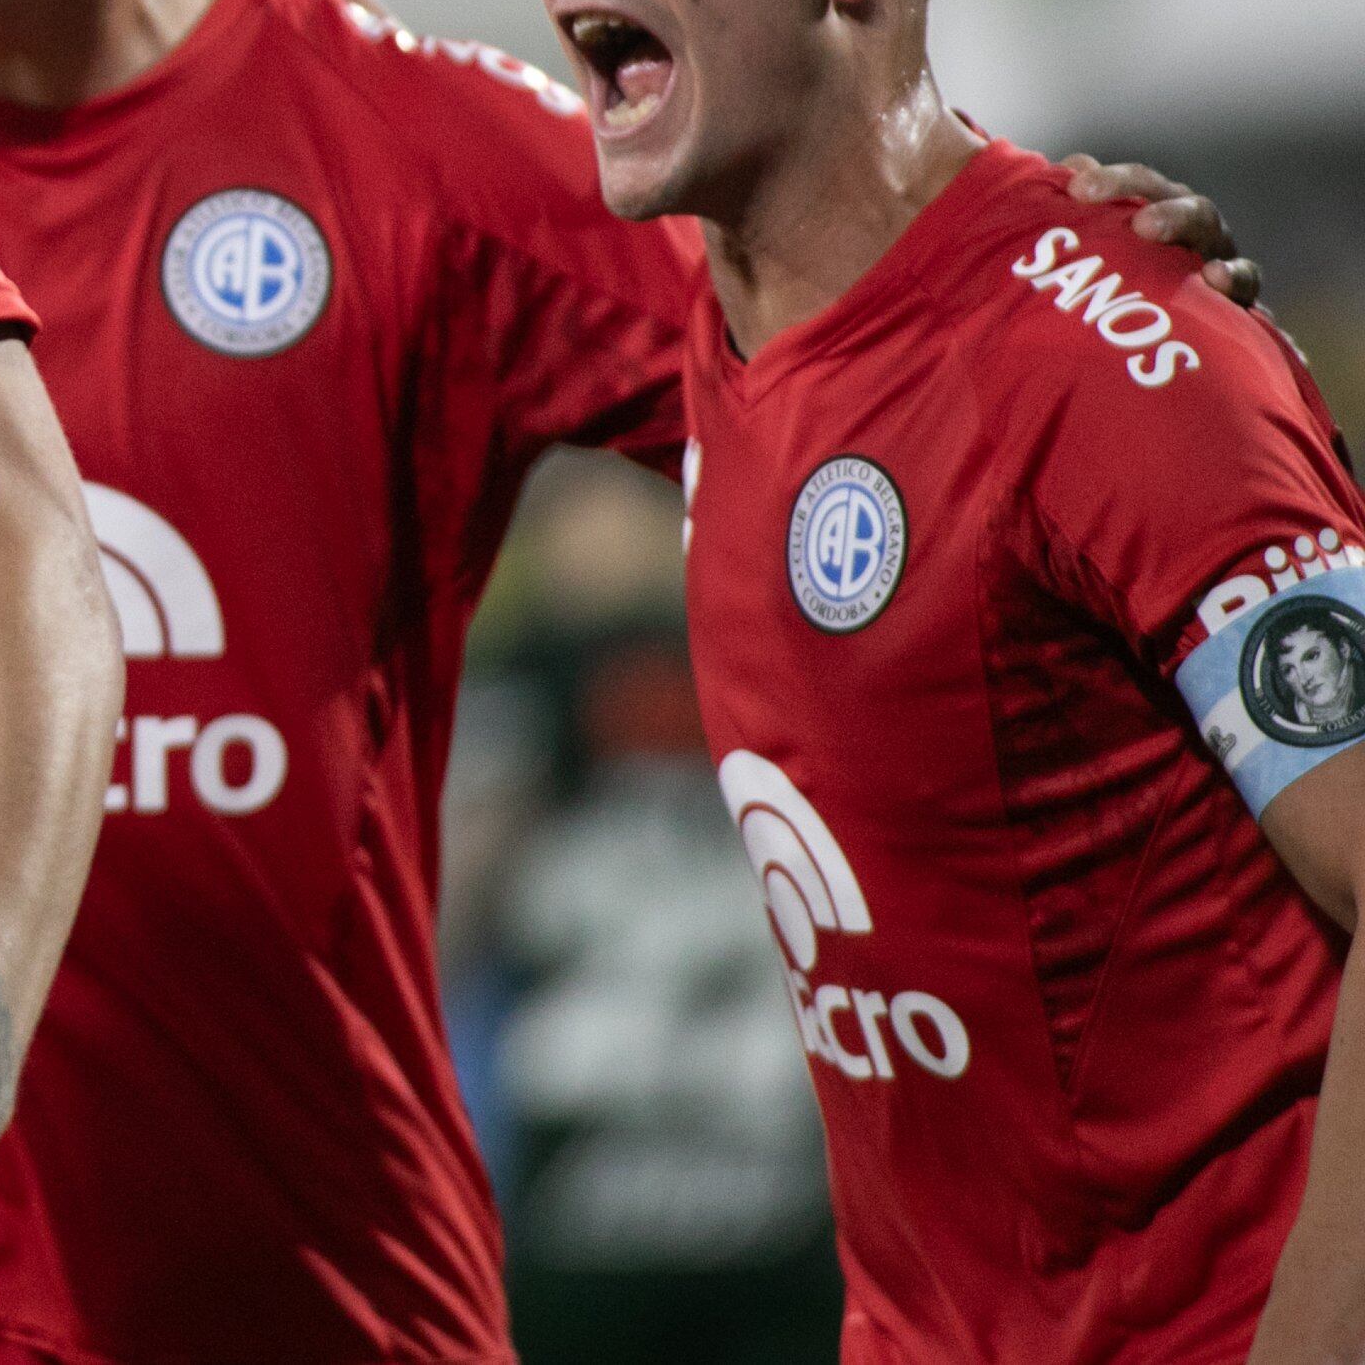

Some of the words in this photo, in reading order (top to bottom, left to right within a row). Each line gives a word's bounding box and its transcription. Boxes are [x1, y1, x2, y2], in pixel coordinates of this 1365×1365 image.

[1011, 226, 1201, 388] SANOS
[873, 476, 902, 587] BELGRANO
[801, 586, 869, 622] CORDOBA
[790, 968, 972, 1079] acro
